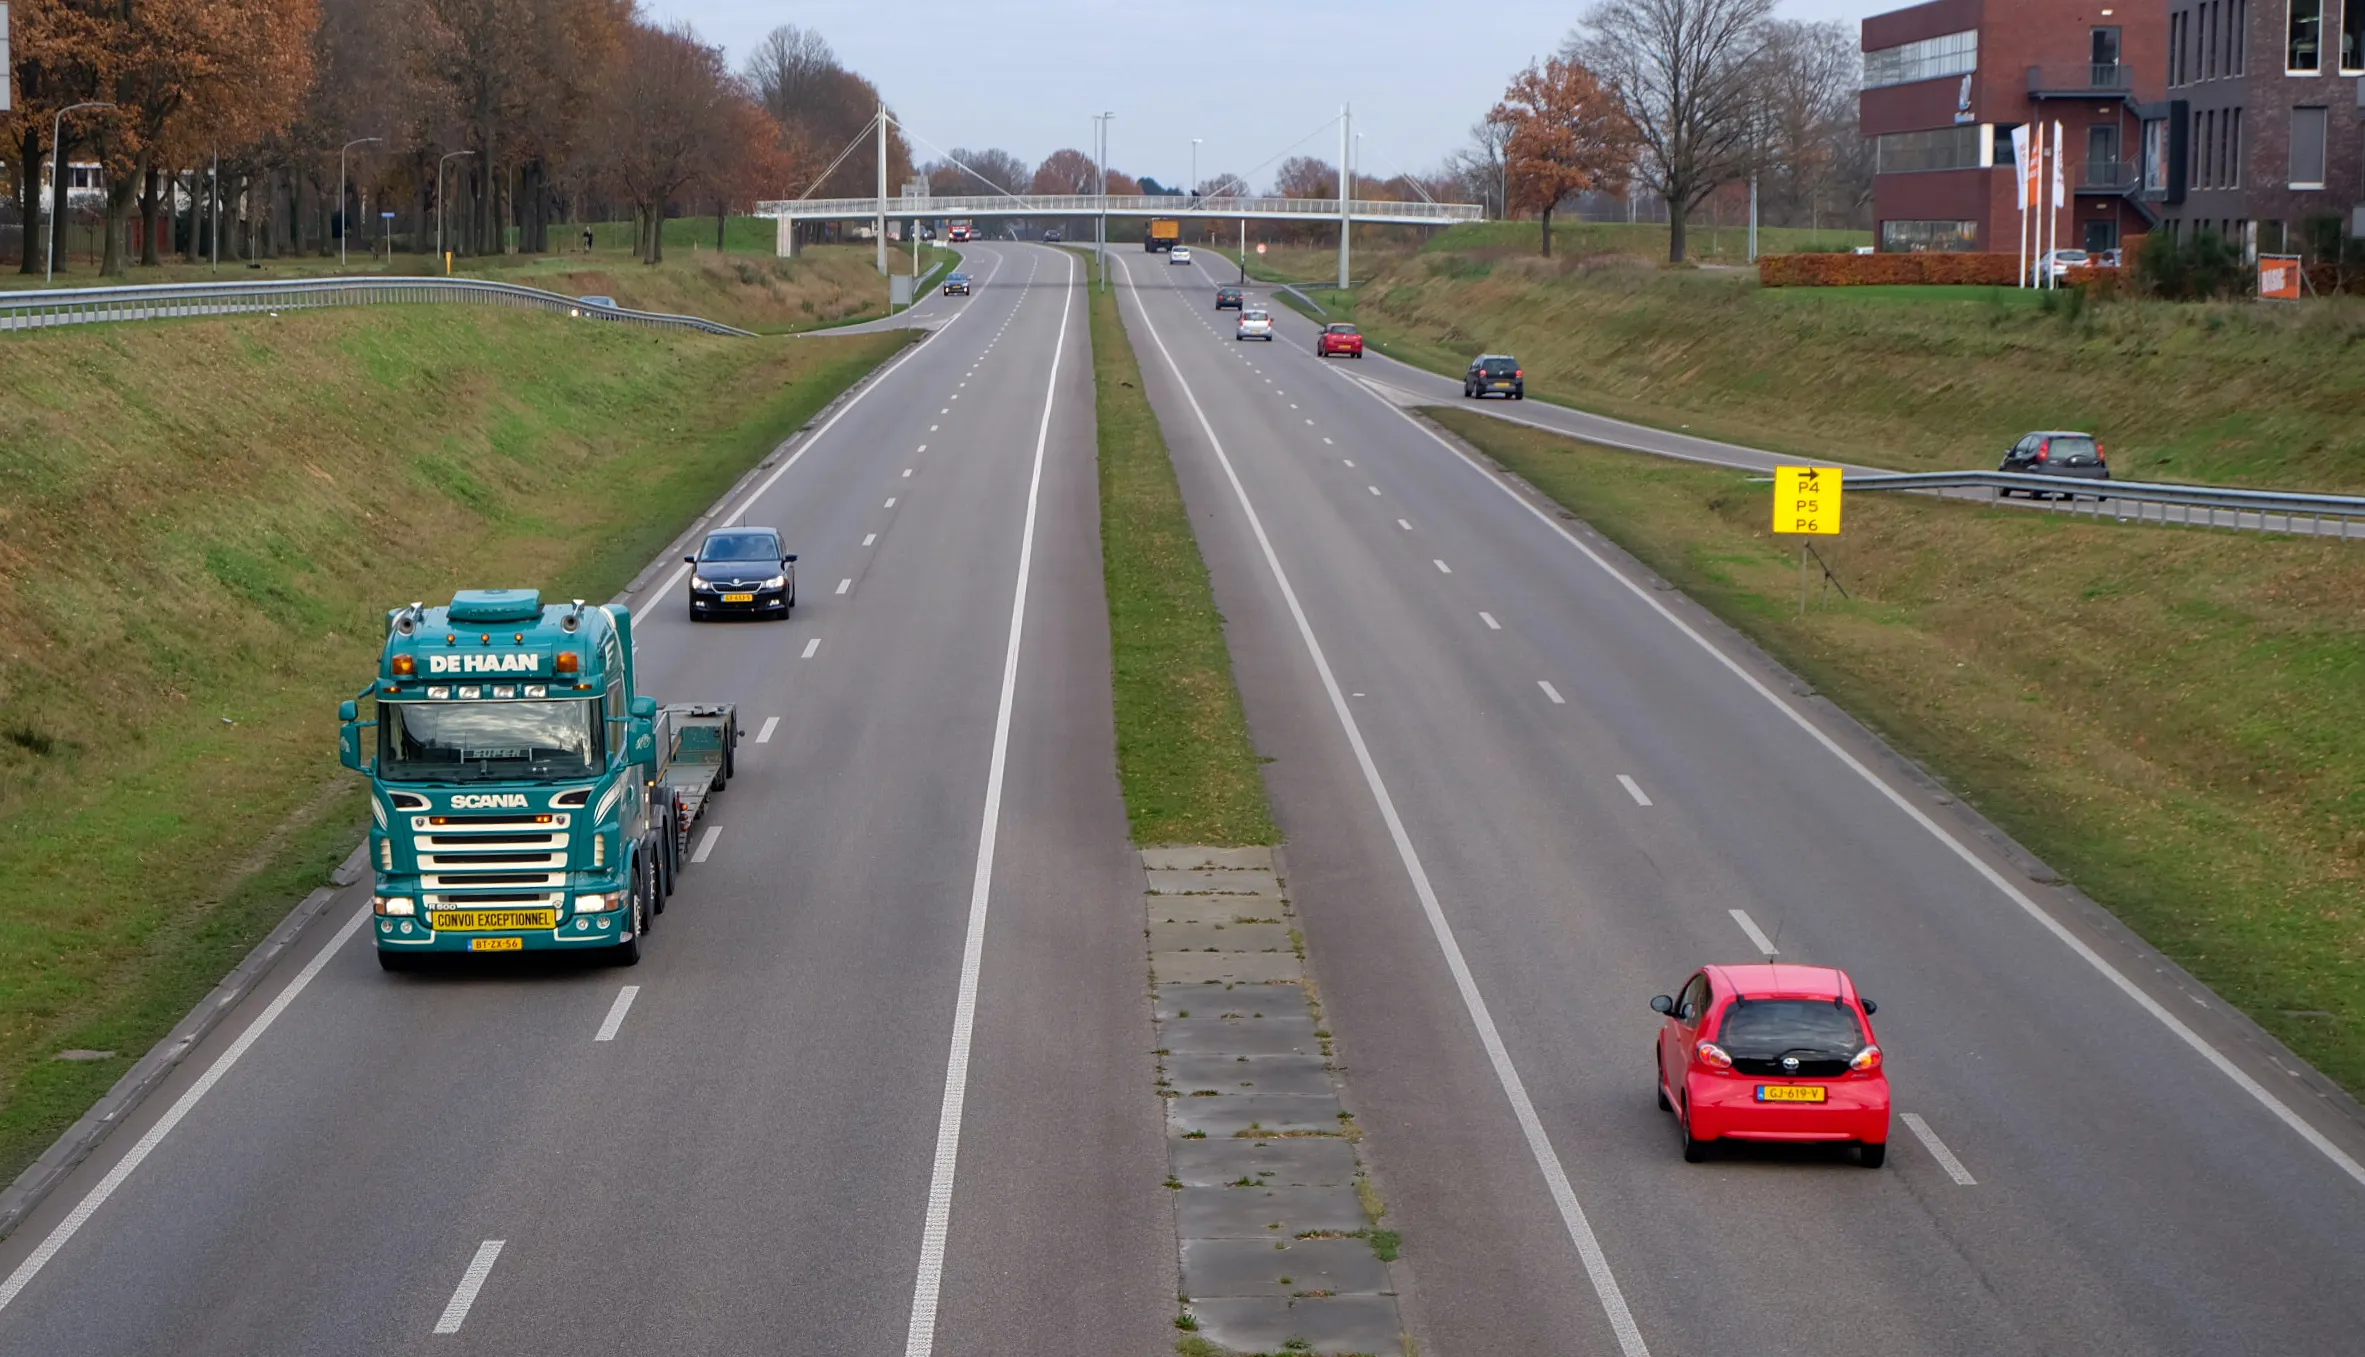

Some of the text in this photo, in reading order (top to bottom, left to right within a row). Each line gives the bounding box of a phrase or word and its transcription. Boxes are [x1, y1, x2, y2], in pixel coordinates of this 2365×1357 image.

[1798, 482, 1820, 494] P4
[1796, 500, 1818, 513] P5
[1796, 519, 1818, 532] P6
[430, 653, 539, 672] DE HAAN
[450, 793, 529, 809] SCANIA
[437, 912, 550, 927] CONVOI EXCEPTIONNEL
[476, 940, 518, 949] BT-ZX-56
[1769, 1087, 1819, 1098] GJ-619-V
